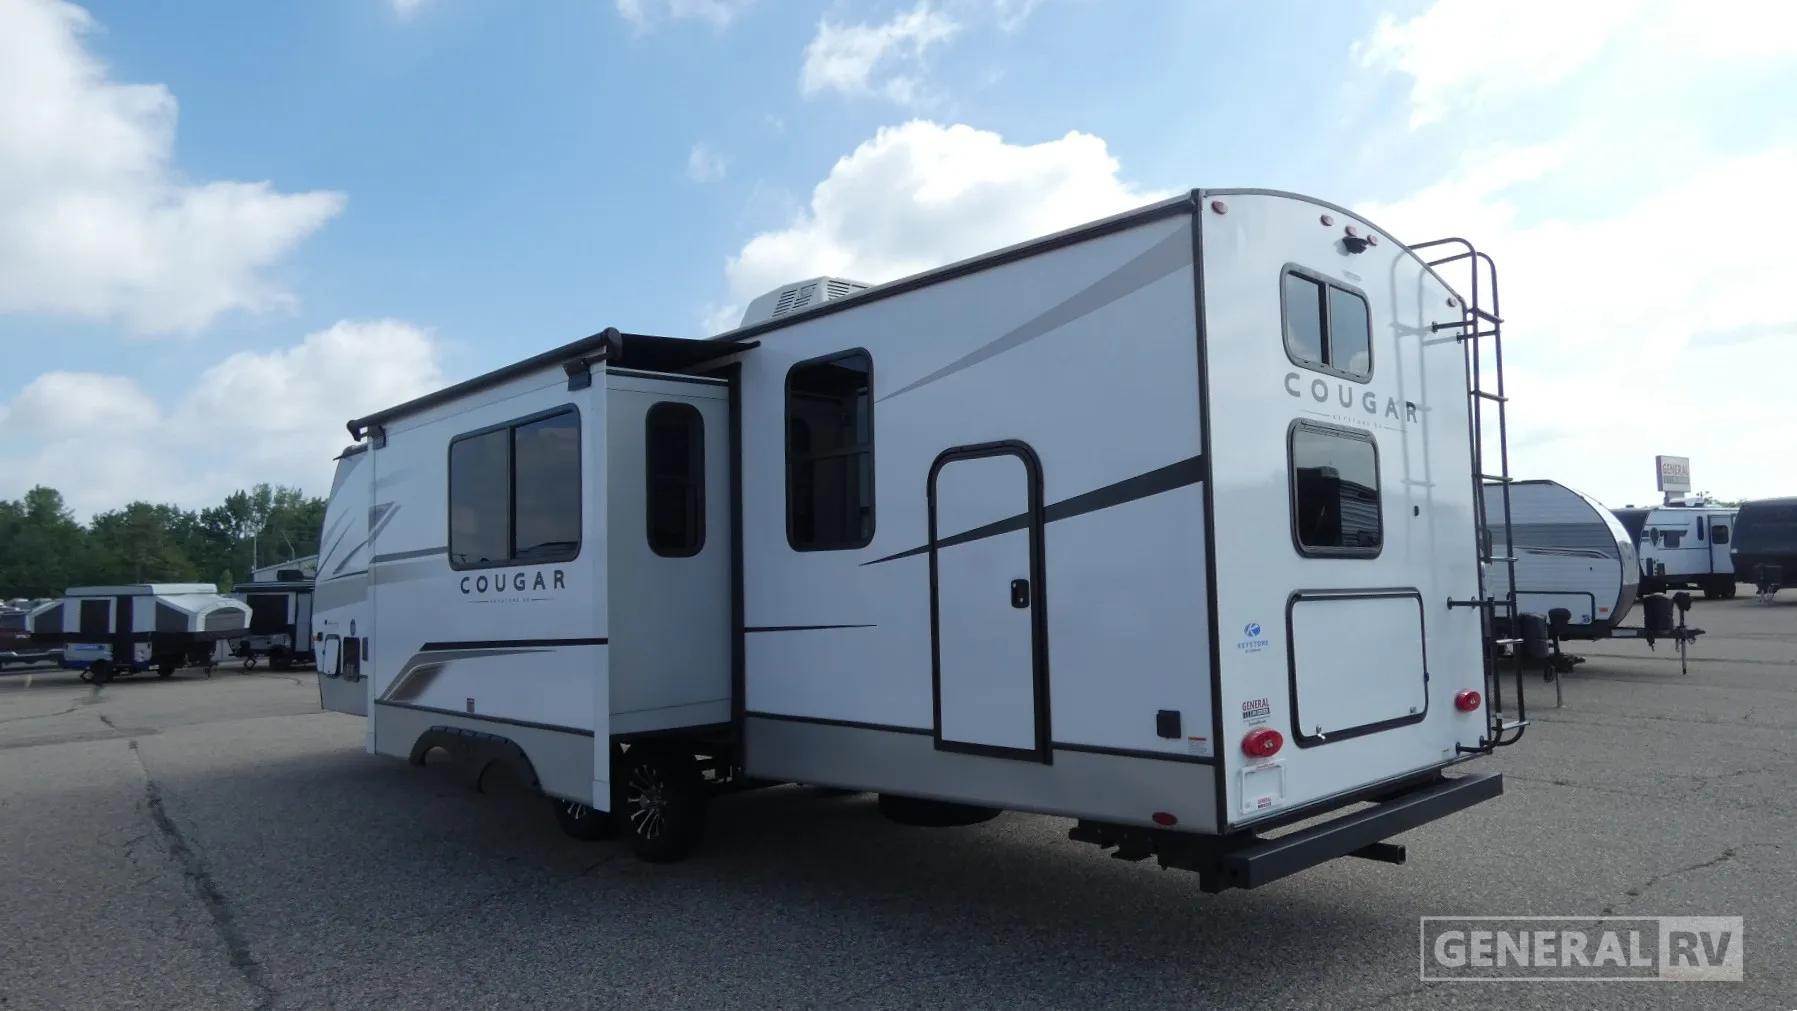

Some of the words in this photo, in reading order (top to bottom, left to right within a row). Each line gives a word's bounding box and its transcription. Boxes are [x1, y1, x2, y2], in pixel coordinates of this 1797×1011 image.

[1284, 372, 1417, 423] COUGAR
[1662, 463, 1689, 475] GENERAL
[460, 570, 565, 594] COUGAR
[1242, 697, 1270, 711] GENERAL
